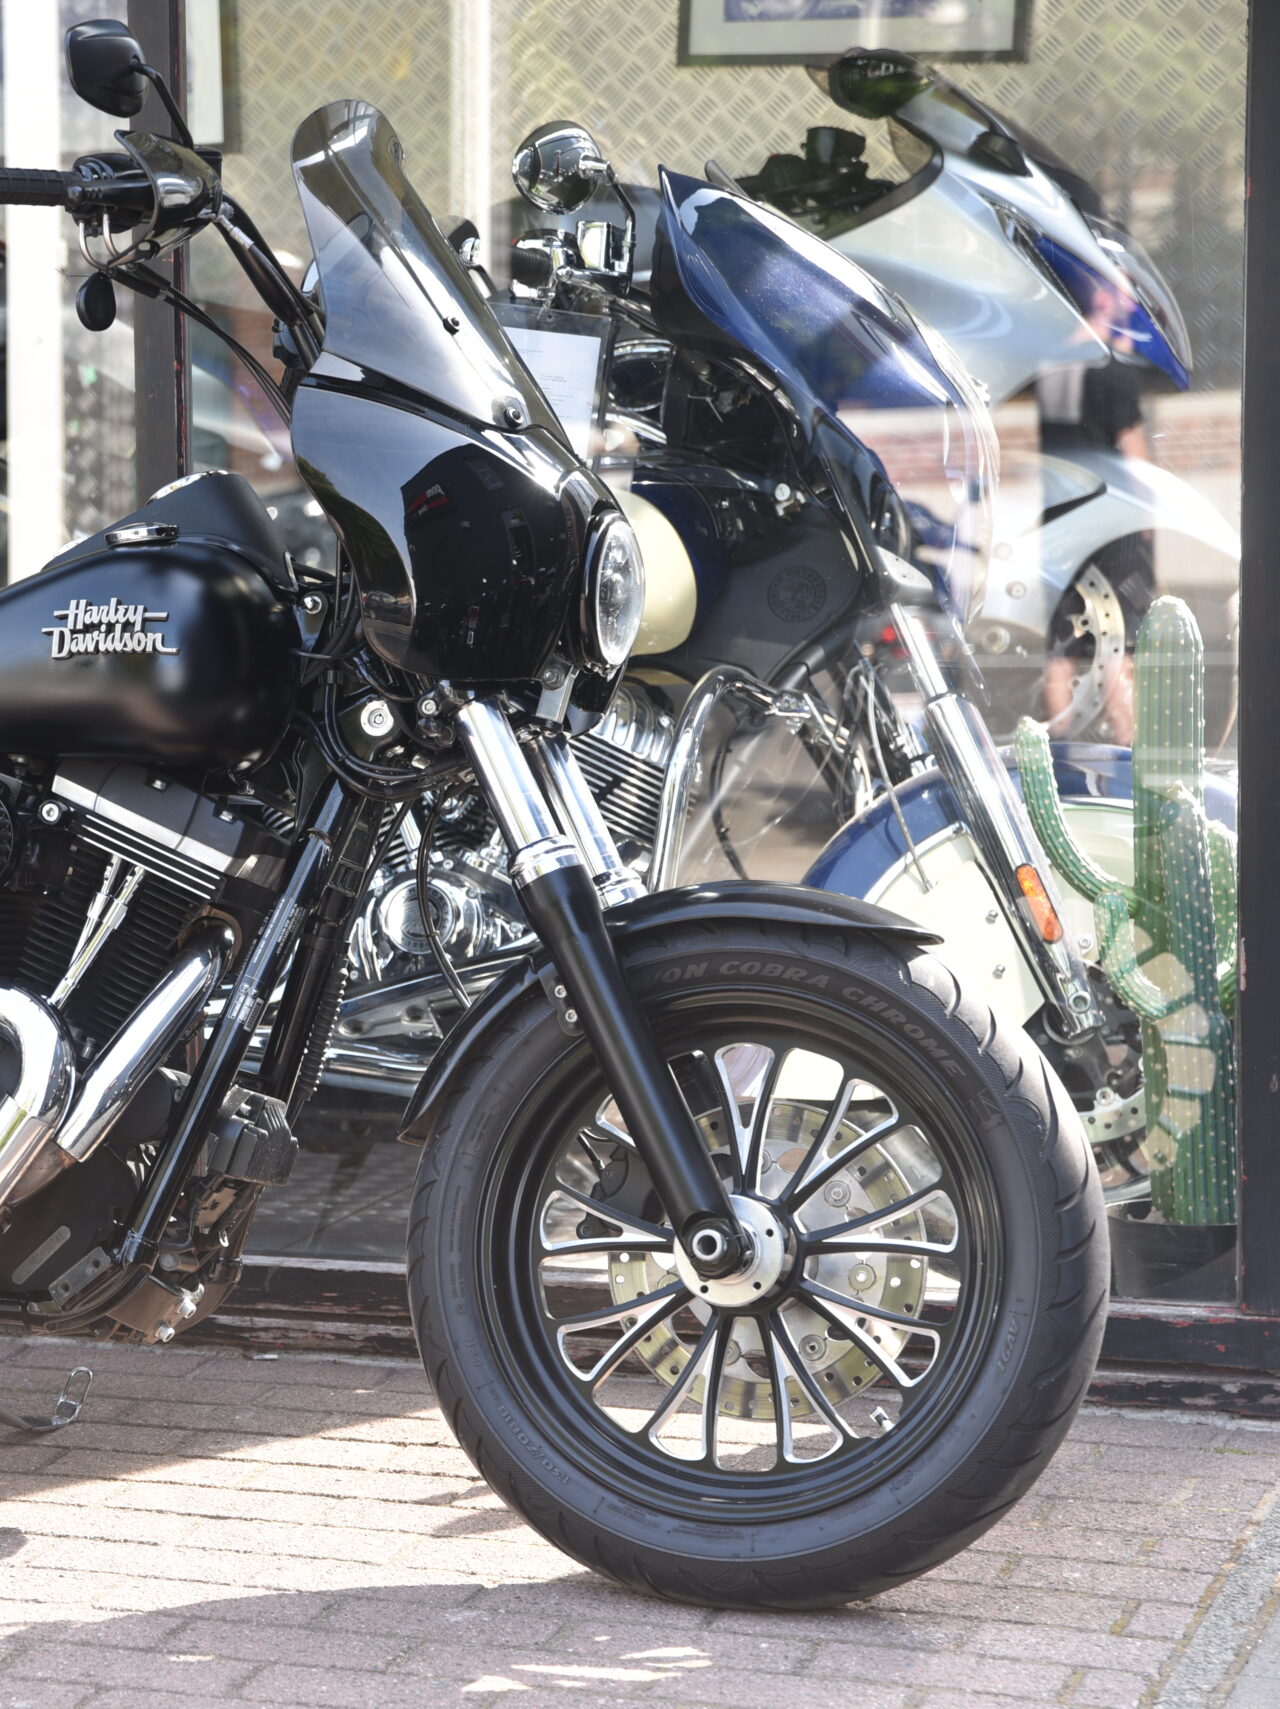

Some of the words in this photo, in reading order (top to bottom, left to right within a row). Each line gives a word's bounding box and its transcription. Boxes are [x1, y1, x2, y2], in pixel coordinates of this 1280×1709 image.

[54, 597, 169, 631] Harley
[42, 623, 180, 659] Davidson
[719, 960, 830, 989] COBRA
[843, 987, 967, 1077] CHROME
